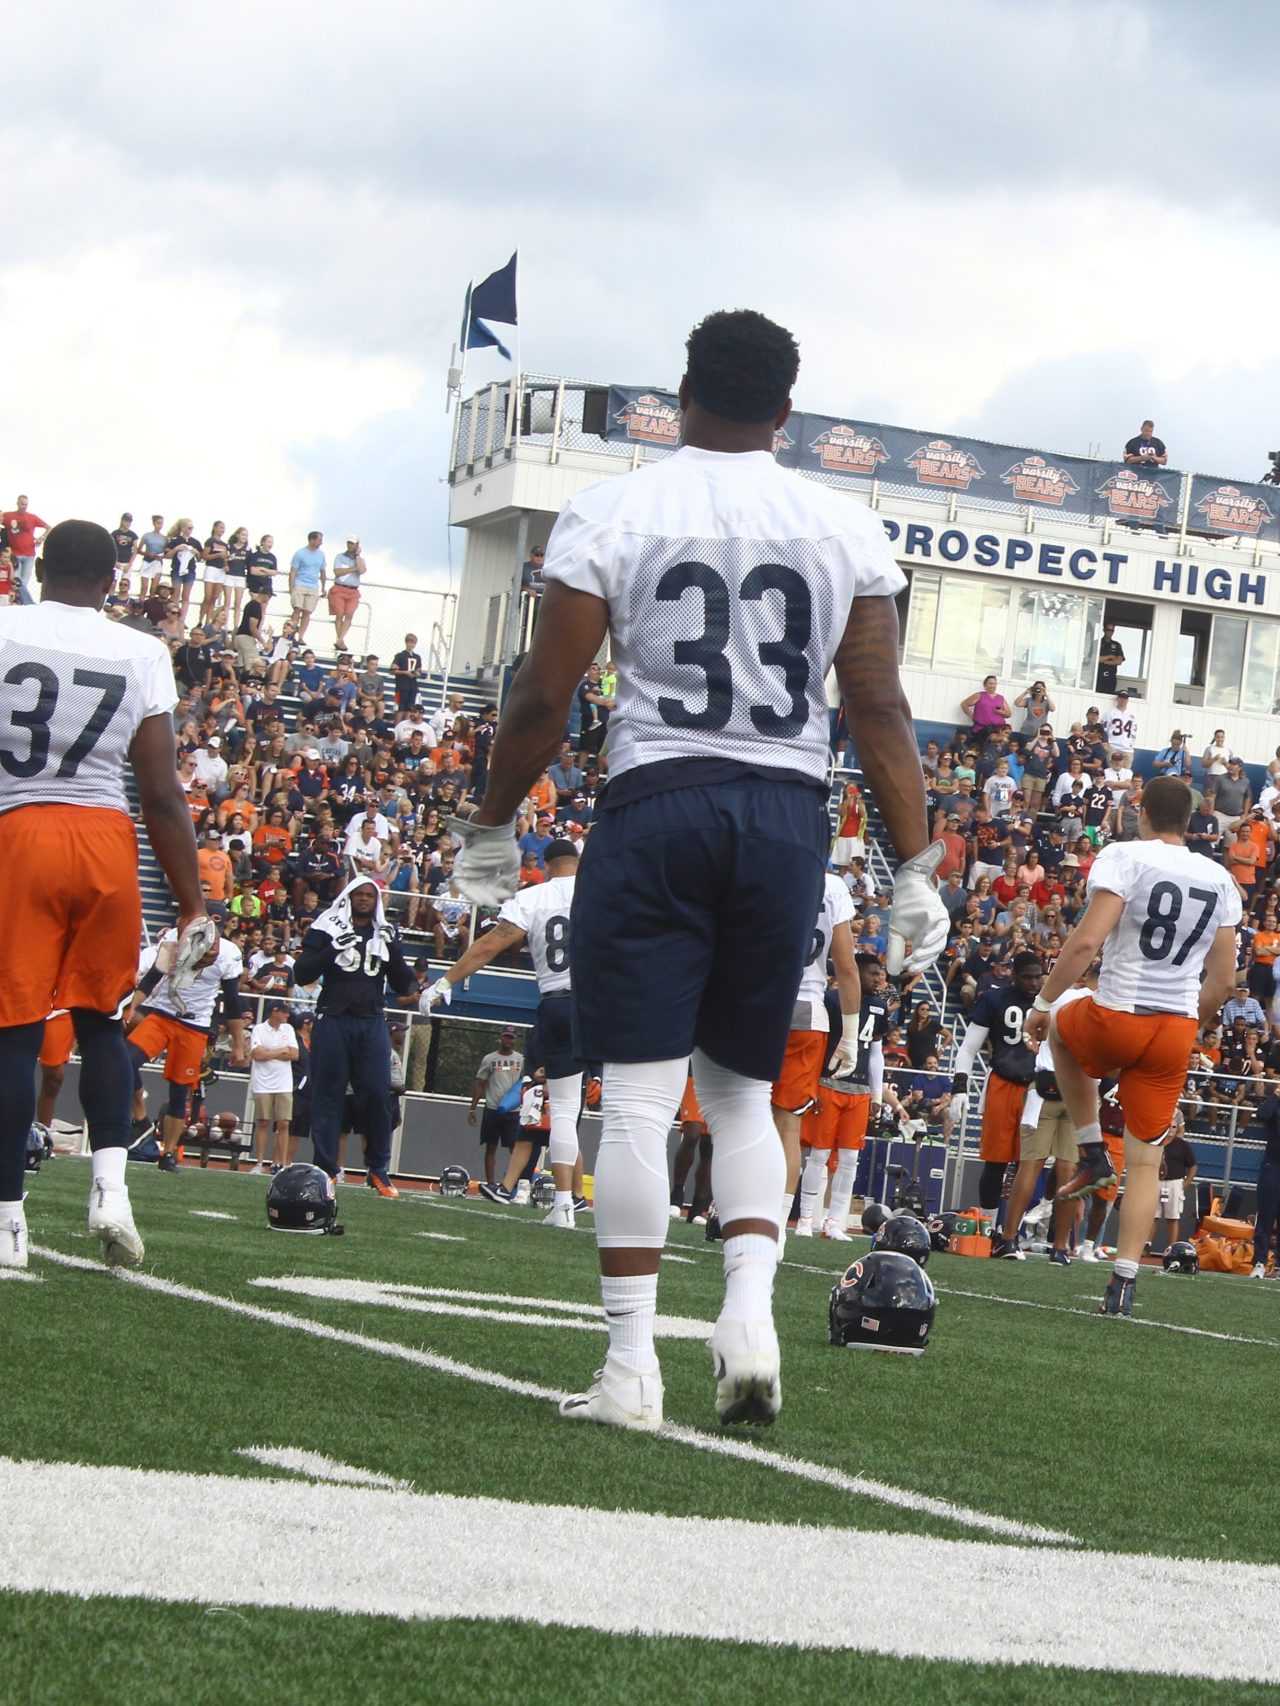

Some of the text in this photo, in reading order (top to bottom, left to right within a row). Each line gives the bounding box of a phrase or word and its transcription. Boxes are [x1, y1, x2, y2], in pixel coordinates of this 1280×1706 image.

[635, 406, 677, 422] varsity
[629, 415, 681, 436] BEARS
[829, 435, 872, 451] varsity
[823, 444, 876, 466] BEARS
[926, 451, 968, 467] varsity
[919, 460, 971, 480] BEARS
[1022, 465, 1063, 483] varsity
[1015, 475, 1066, 497] BEARS
[1115, 480, 1155, 496] varsity
[1111, 489, 1160, 510] BEARS
[1215, 495, 1258, 512] varsity
[1210, 505, 1262, 524] BEARS
[1153, 560, 1266, 605] HIGH
[655, 561, 812, 739] 33
[2, 662, 127, 779] 37
[1111, 718, 1132, 738] 34
[340, 783, 356, 801] 34
[1090, 792, 1106, 810] 22
[1138, 880, 1218, 967] 87
